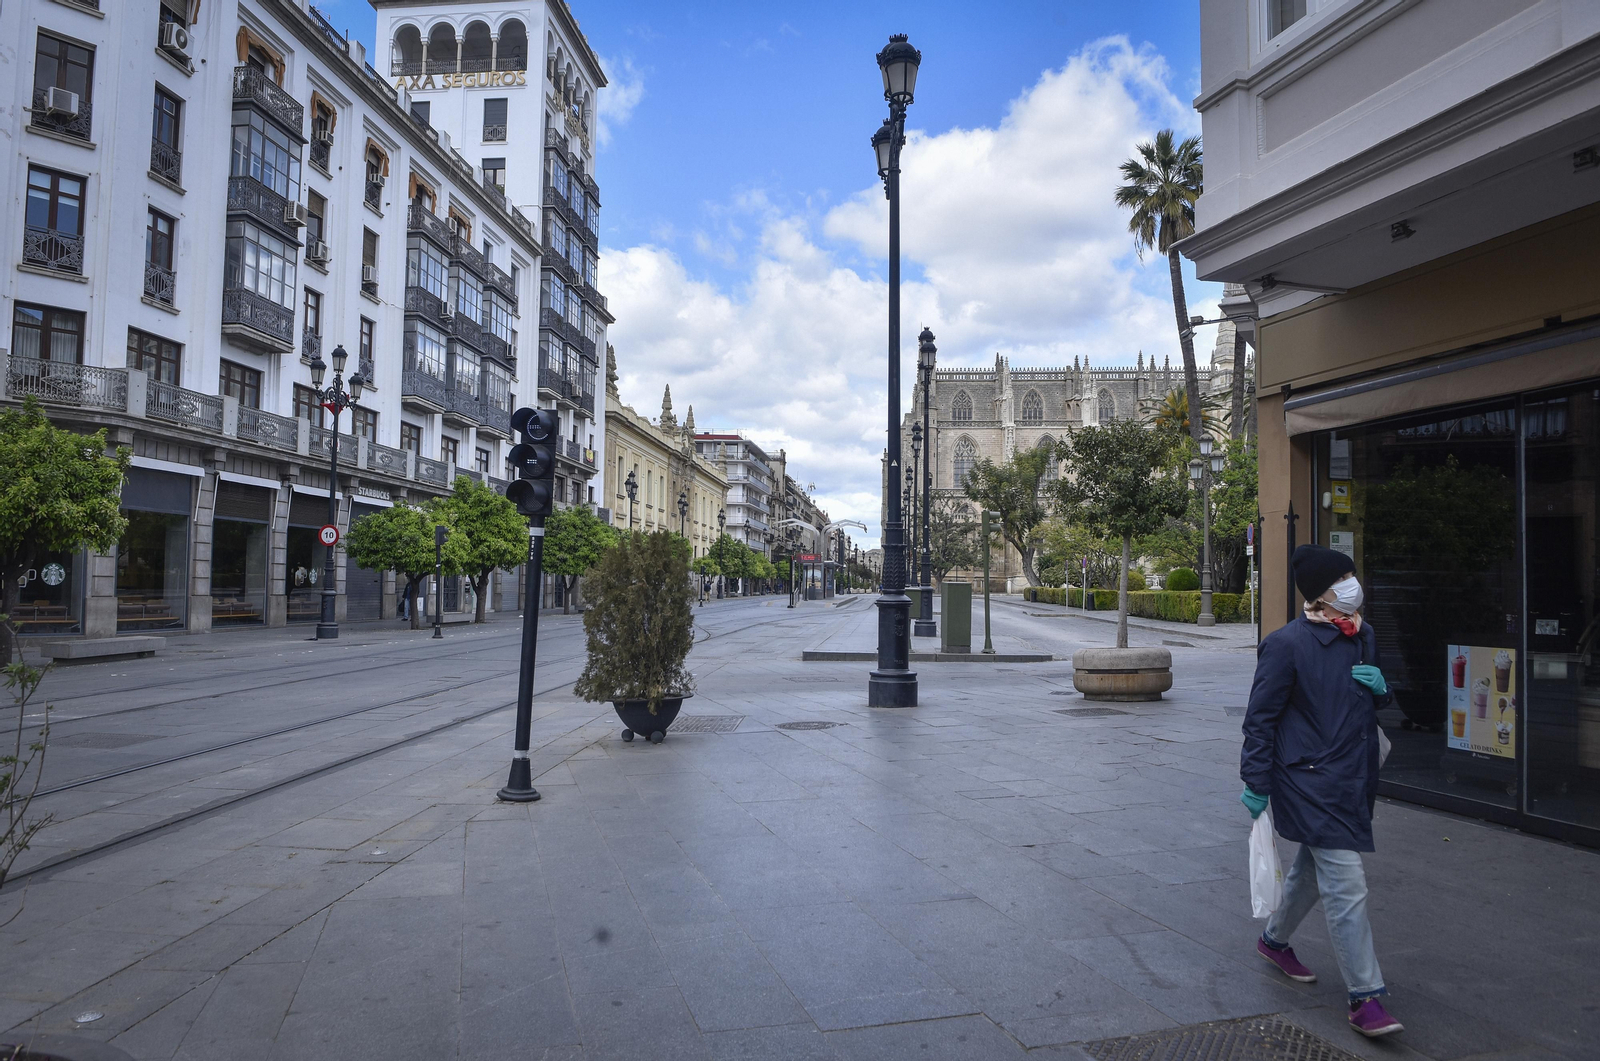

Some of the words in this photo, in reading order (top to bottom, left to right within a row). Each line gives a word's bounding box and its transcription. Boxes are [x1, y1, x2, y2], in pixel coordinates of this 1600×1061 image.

[394, 74, 436, 90] AXA
[442, 70, 526, 88] SEGUROS
[358, 486, 390, 500] STARBUCKS
[324, 531, 334, 539] 10
[1482, 746, 1502, 754] DRINKS
